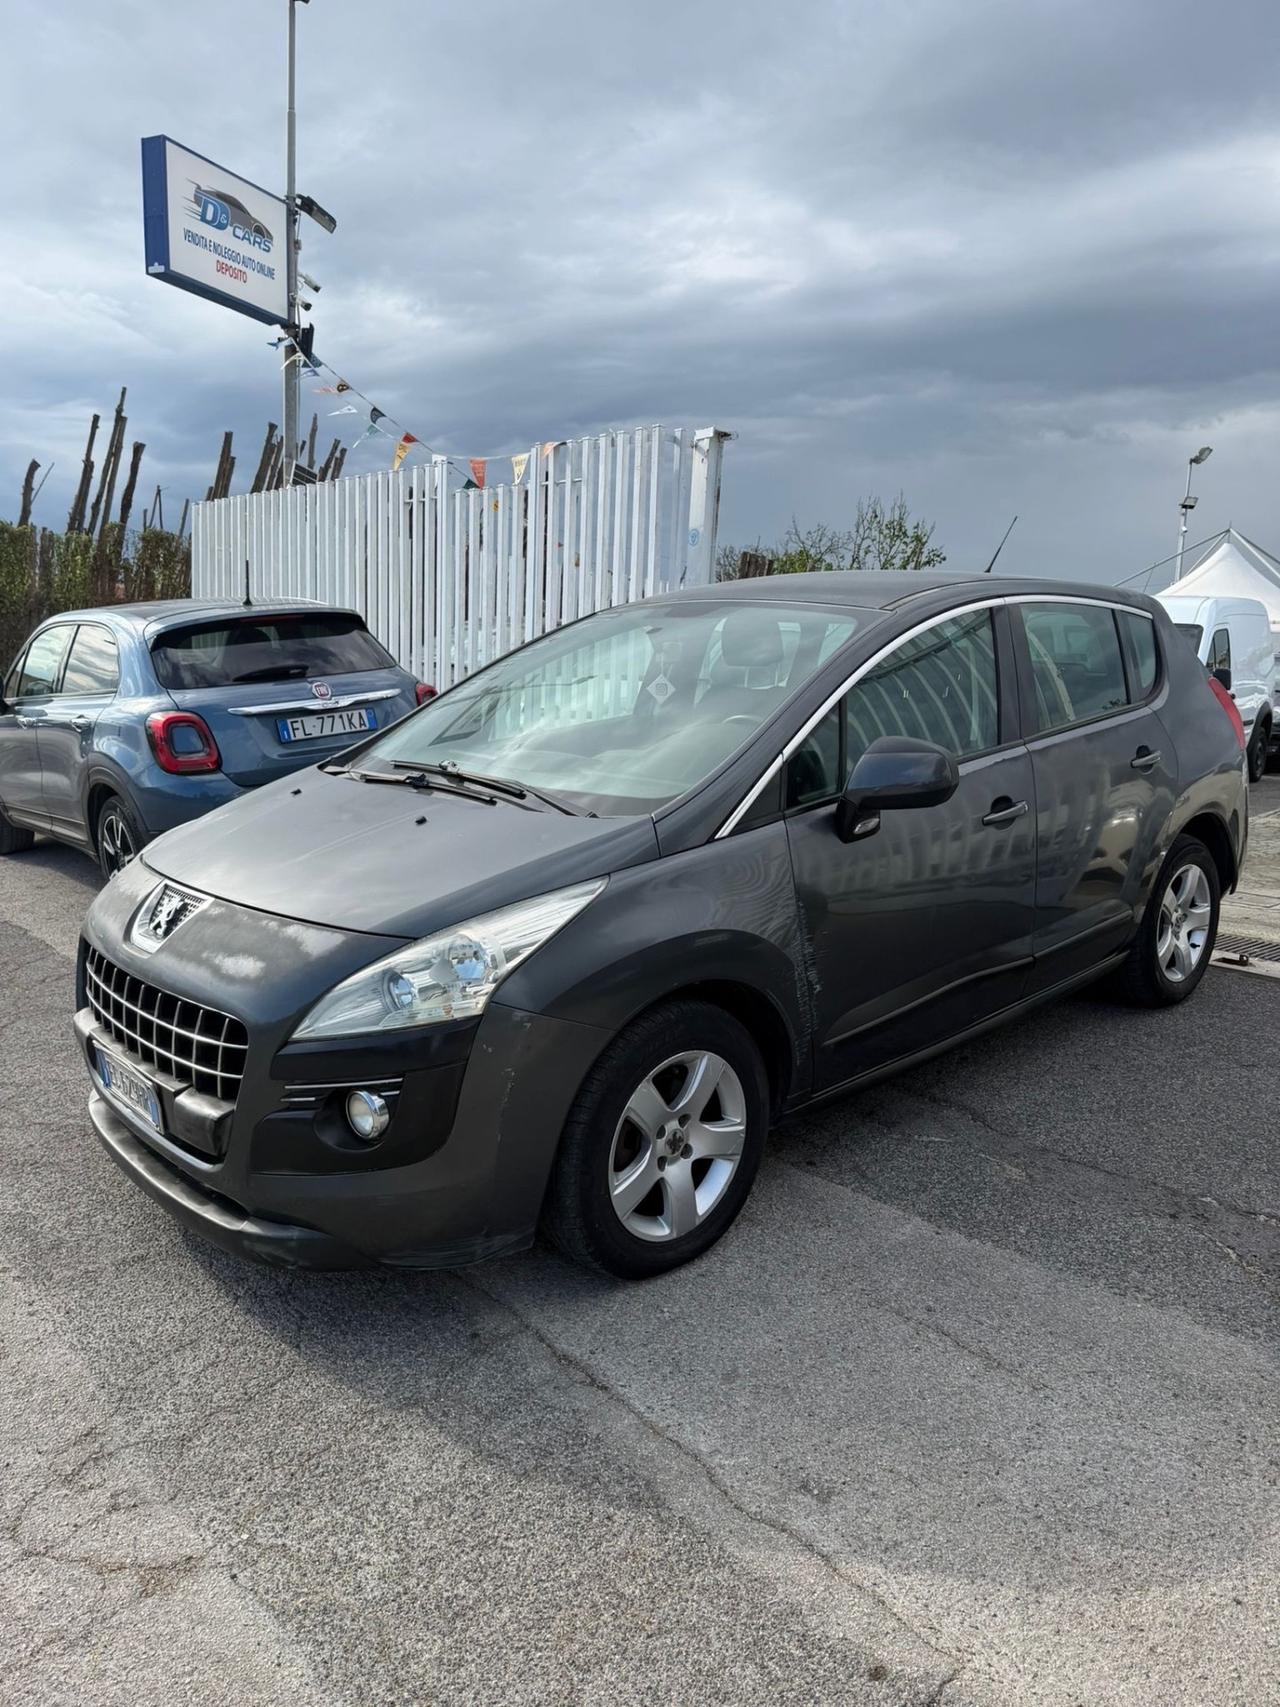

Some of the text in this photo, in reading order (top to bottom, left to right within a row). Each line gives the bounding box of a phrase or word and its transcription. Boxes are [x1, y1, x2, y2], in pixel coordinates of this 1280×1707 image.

[232, 224, 271, 253] CARS
[183, 227, 208, 251] VENDITA
[213, 241, 241, 265] NOLEGGIO
[241, 254, 256, 272] AUTO
[256, 261, 275, 280] ONLINE
[216, 259, 247, 284] DEPOSITO
